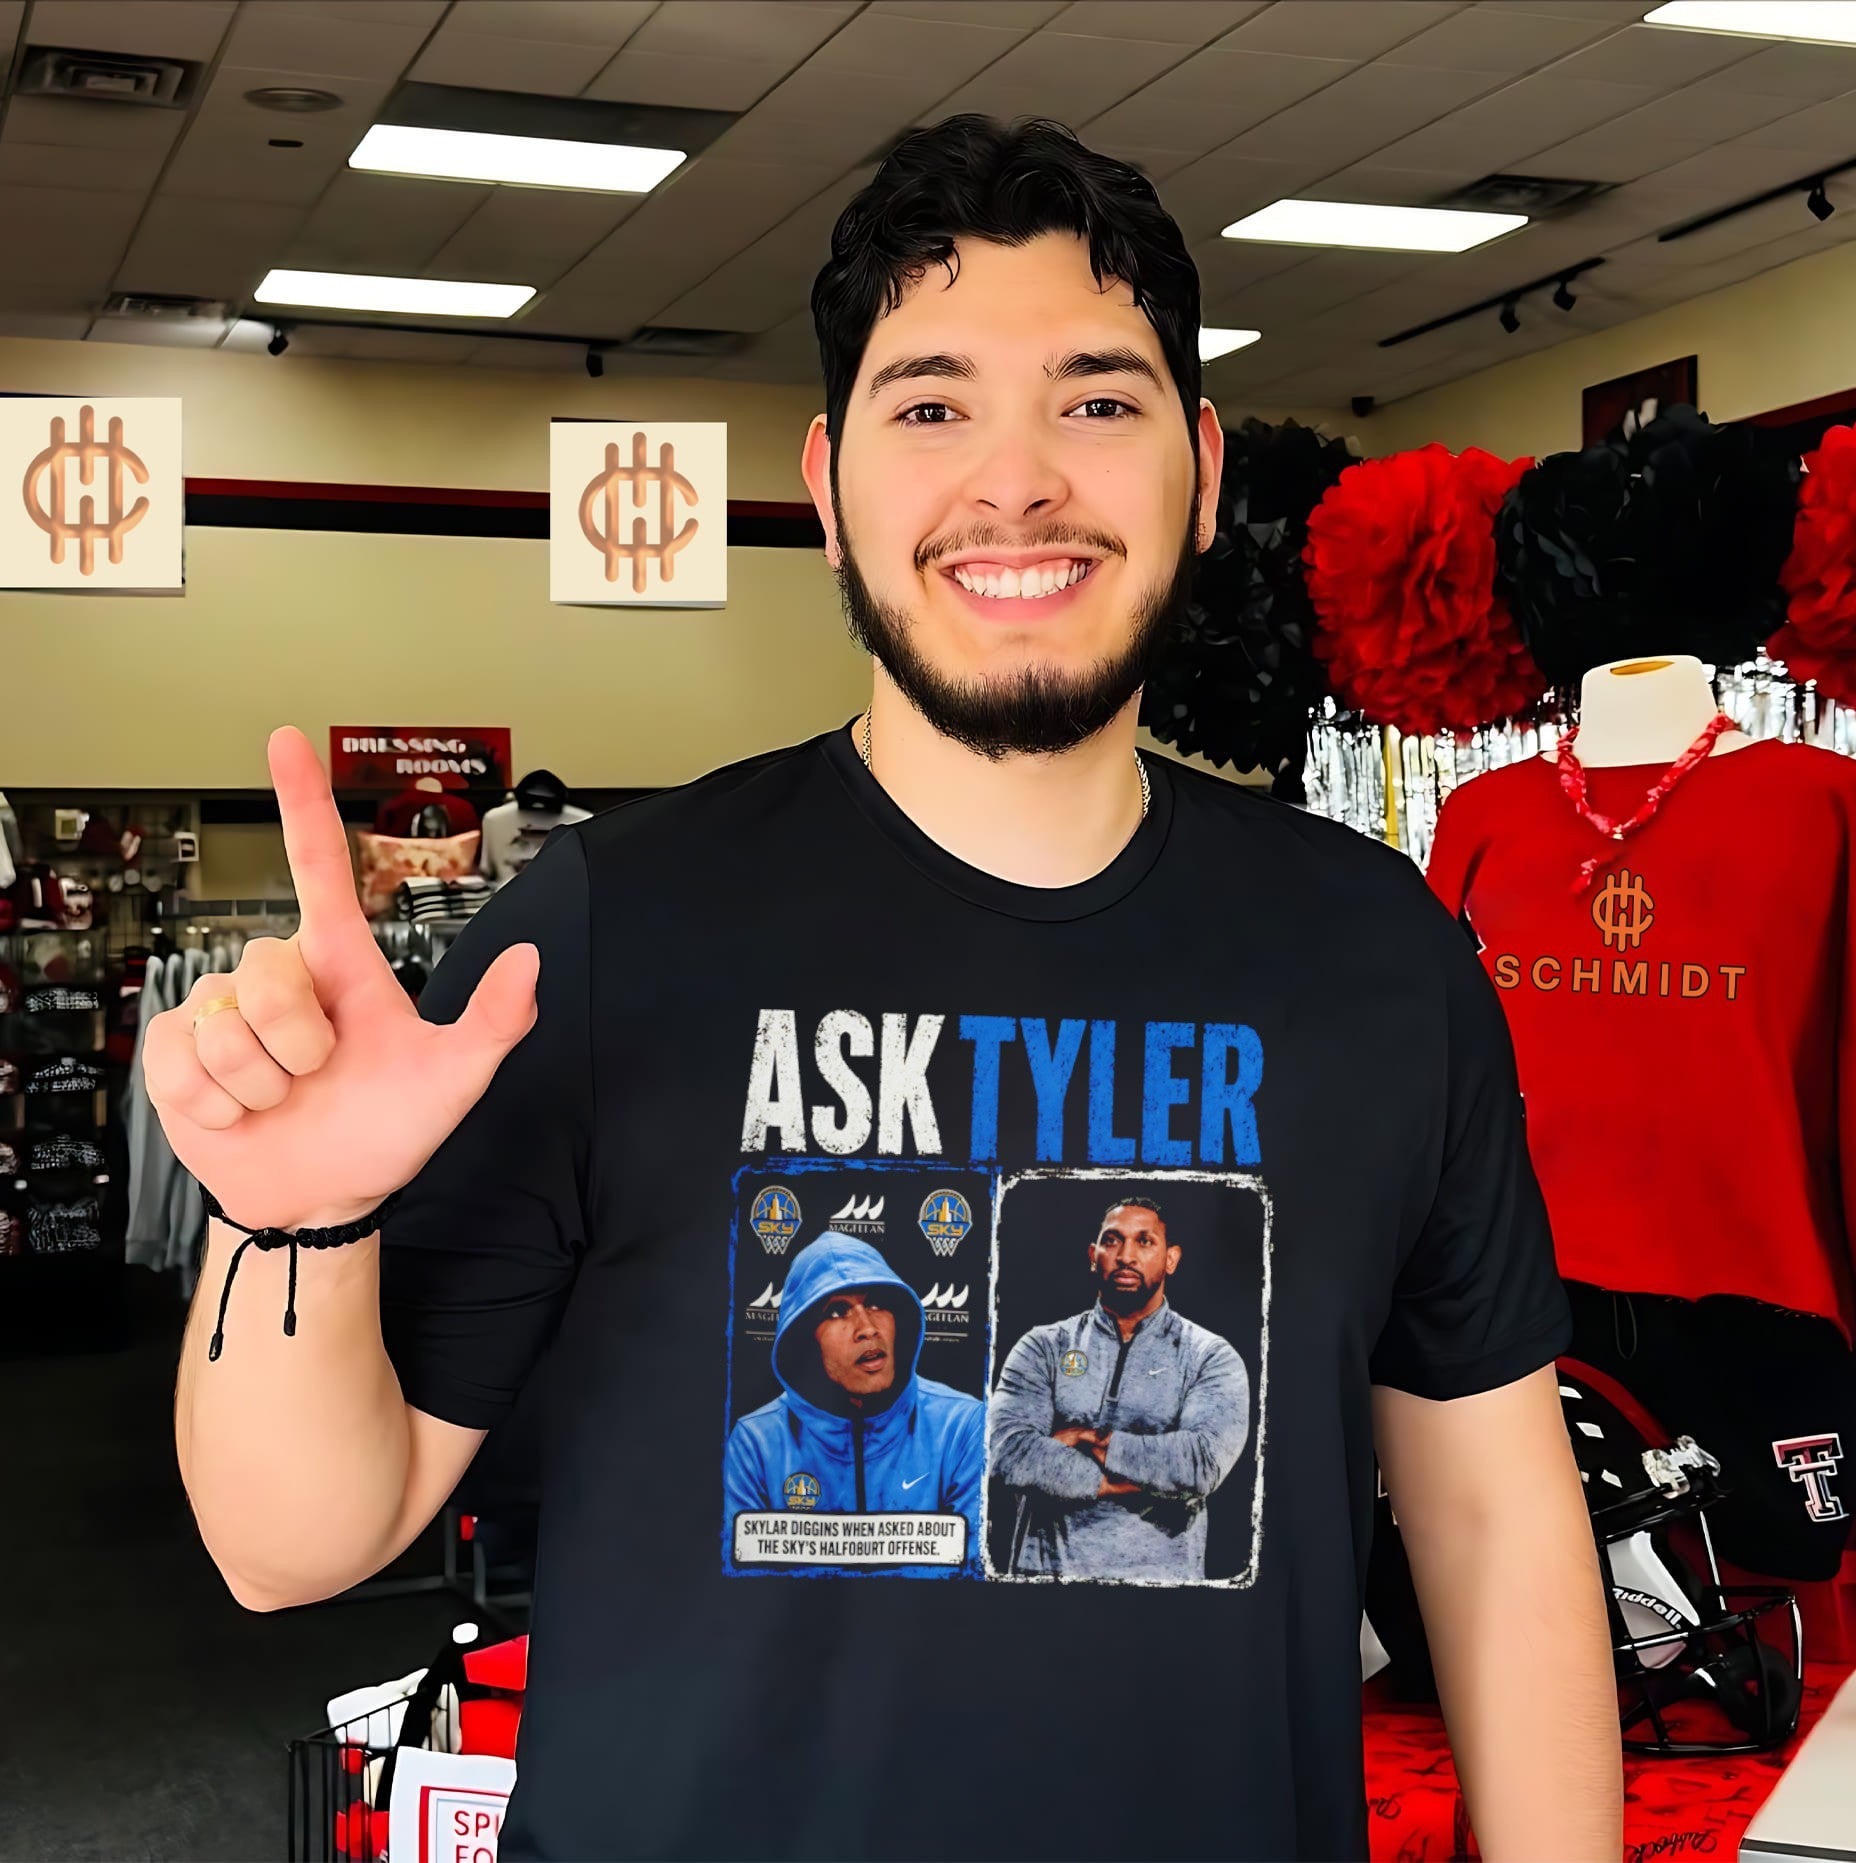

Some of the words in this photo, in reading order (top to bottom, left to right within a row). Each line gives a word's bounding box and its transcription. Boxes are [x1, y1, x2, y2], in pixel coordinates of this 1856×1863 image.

[1494, 953, 1746, 1000] SCHMIDT
[740, 1008, 946, 1155] ASK
[958, 1014, 1264, 1167] TYLER
[758, 1221, 794, 1235] SKY
[829, 1223, 885, 1234] MAGELLAN
[927, 1223, 964, 1237] SKY
[744, 1520, 787, 1535] SKYLAR
[791, 1520, 839, 1537] DIGGINS
[843, 1522, 875, 1537] WHEN
[878, 1521, 914, 1537] ASKED
[917, 1522, 956, 1538] ABOUT
[758, 1539, 778, 1554] THE
[782, 1540, 817, 1556] SKY'S
[820, 1541, 885, 1557] HALFOBURT
[888, 1541, 940, 1556] OFFENSE.
